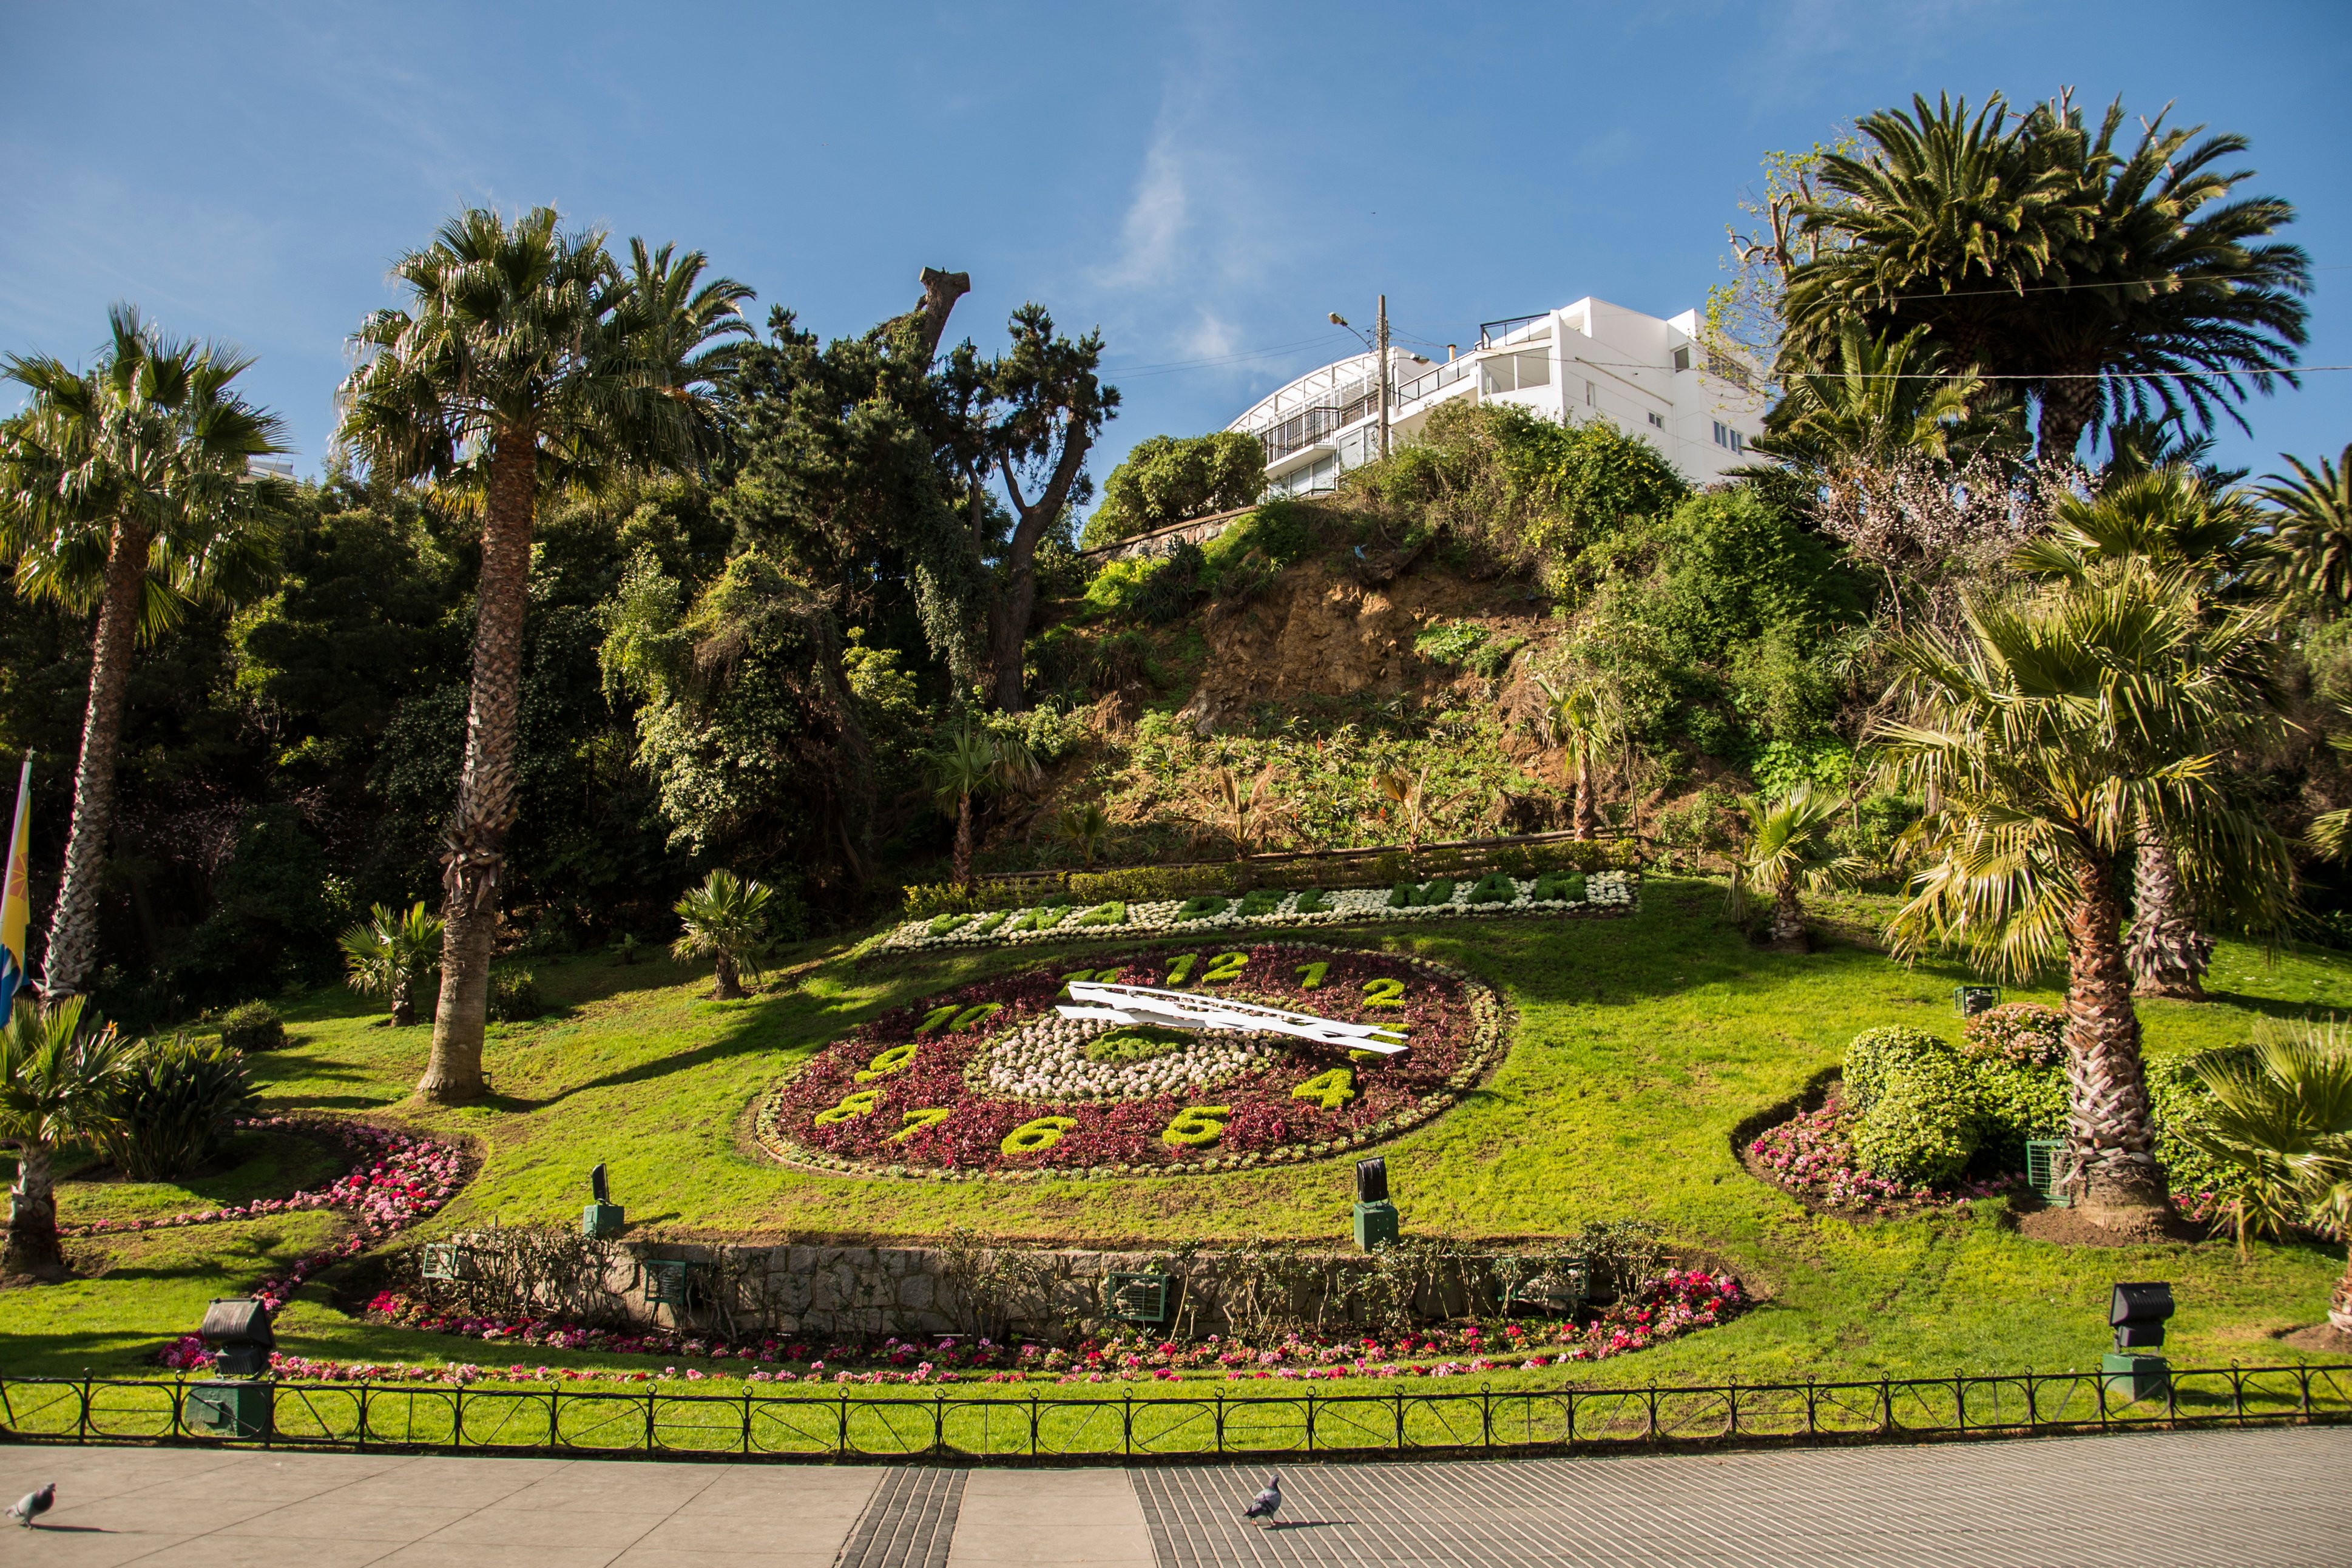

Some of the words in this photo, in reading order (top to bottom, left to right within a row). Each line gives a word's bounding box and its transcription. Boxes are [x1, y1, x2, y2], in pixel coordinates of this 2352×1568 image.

[1178, 888, 1335, 922] DEL
[1387, 871, 1586, 907] MAR
[1166, 951, 1249, 985] 12
[1296, 962, 1330, 988] 1
[1362, 978, 1405, 1007] 2
[914, 1002, 1003, 1033] 10
[854, 1044, 917, 1083] 9
[1292, 1068, 1355, 1109] 4
[814, 1090, 881, 1126] 8
[880, 1108, 949, 1144] 7
[1001, 1116, 1078, 1154] 6
[1163, 1106, 1231, 1147] 5
